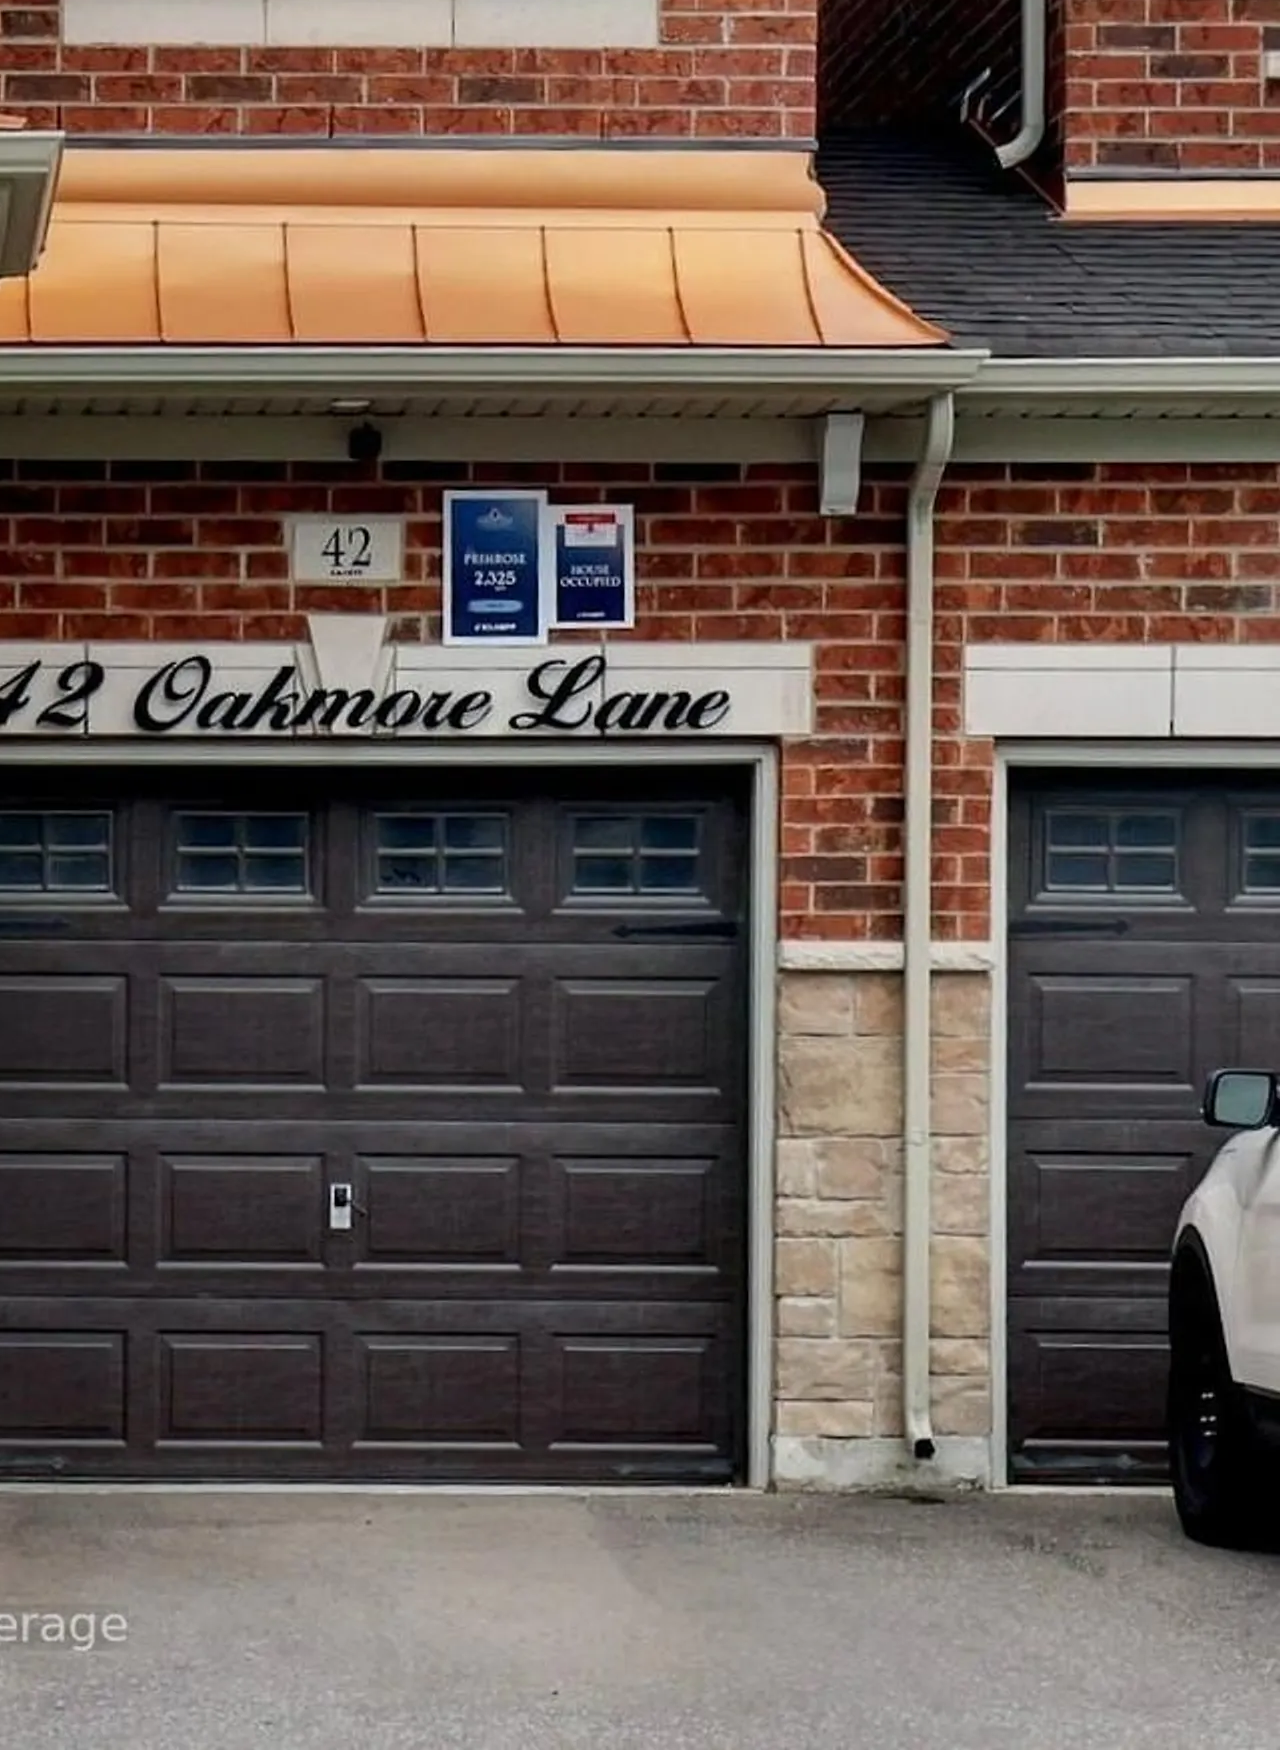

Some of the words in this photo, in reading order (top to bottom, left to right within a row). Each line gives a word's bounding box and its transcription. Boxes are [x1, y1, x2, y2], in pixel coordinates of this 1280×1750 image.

[321, 526, 371, 567] 42
[133, 654, 492, 732] Oakmore
[508, 656, 731, 732] Lane
